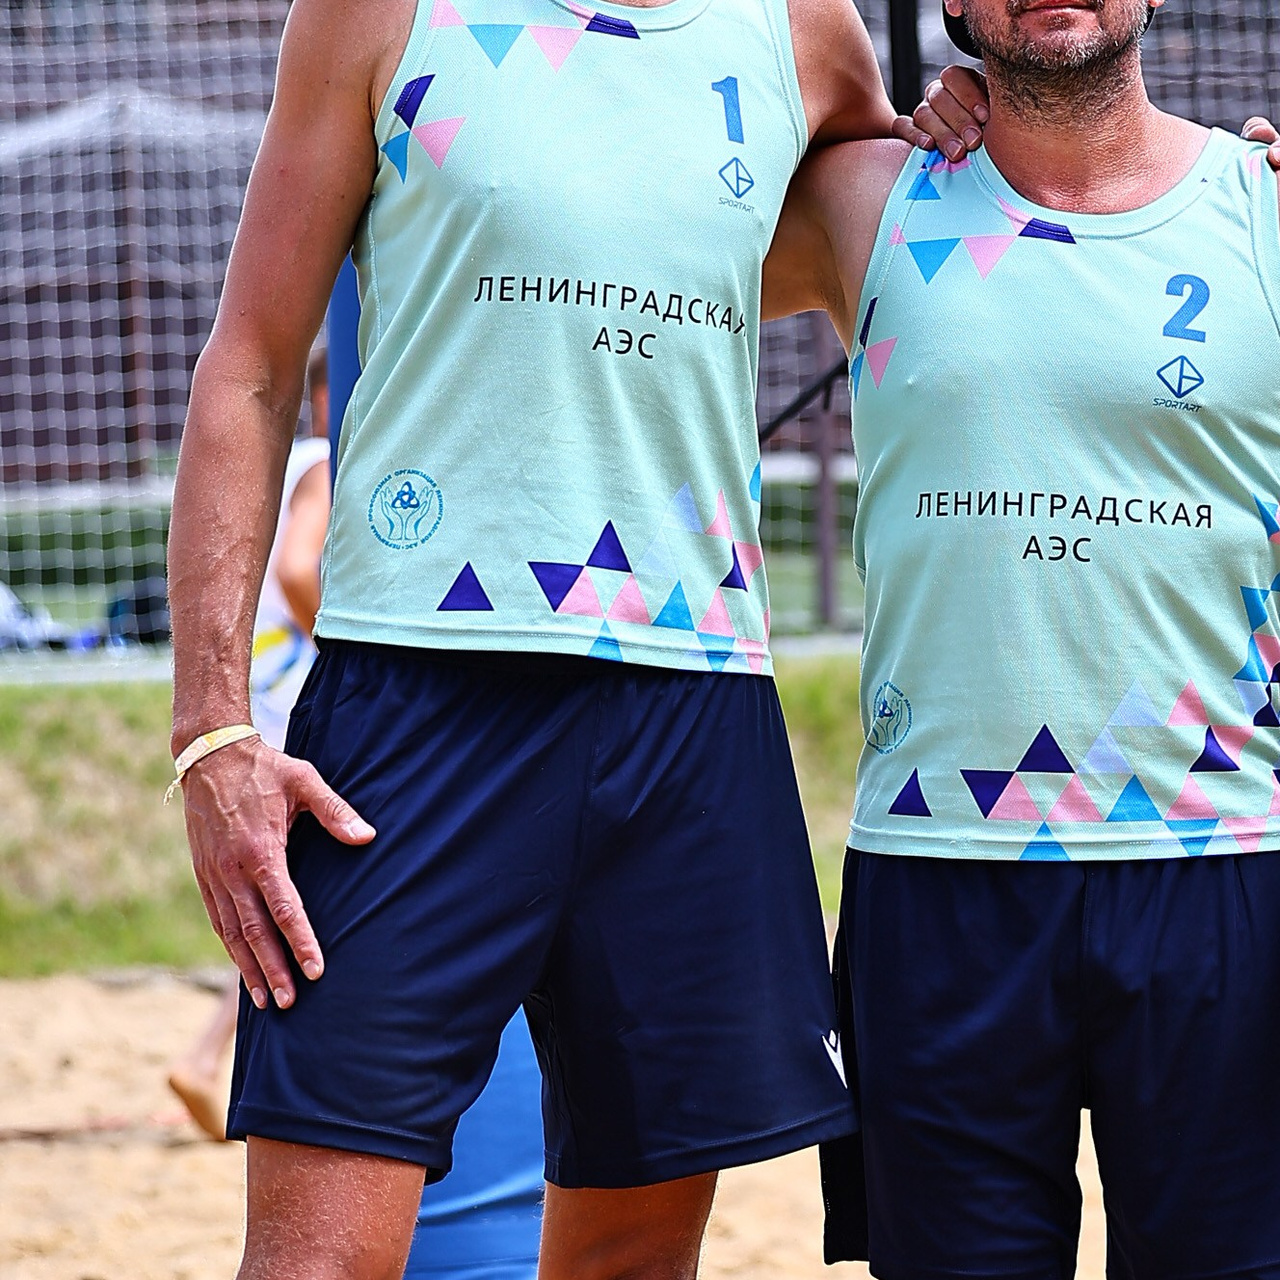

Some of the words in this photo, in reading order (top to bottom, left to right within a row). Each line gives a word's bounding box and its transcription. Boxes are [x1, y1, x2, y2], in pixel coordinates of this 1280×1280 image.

[711, 75, 745, 145] 1
[717, 196, 756, 214] SPORTART
[474, 276, 746, 337] ЛЕНИНГРАДСКАЯ
[1162, 273, 1211, 343] 2
[592, 326, 657, 359] АЭС
[1152, 397, 1203, 413] SPORTART
[395, 470, 437, 487] ОРГАНИЗАЦИЯ
[915, 491, 1212, 529] ЛЕНИНГРАДСКАЯ
[1022, 535, 1092, 563] АЭС
